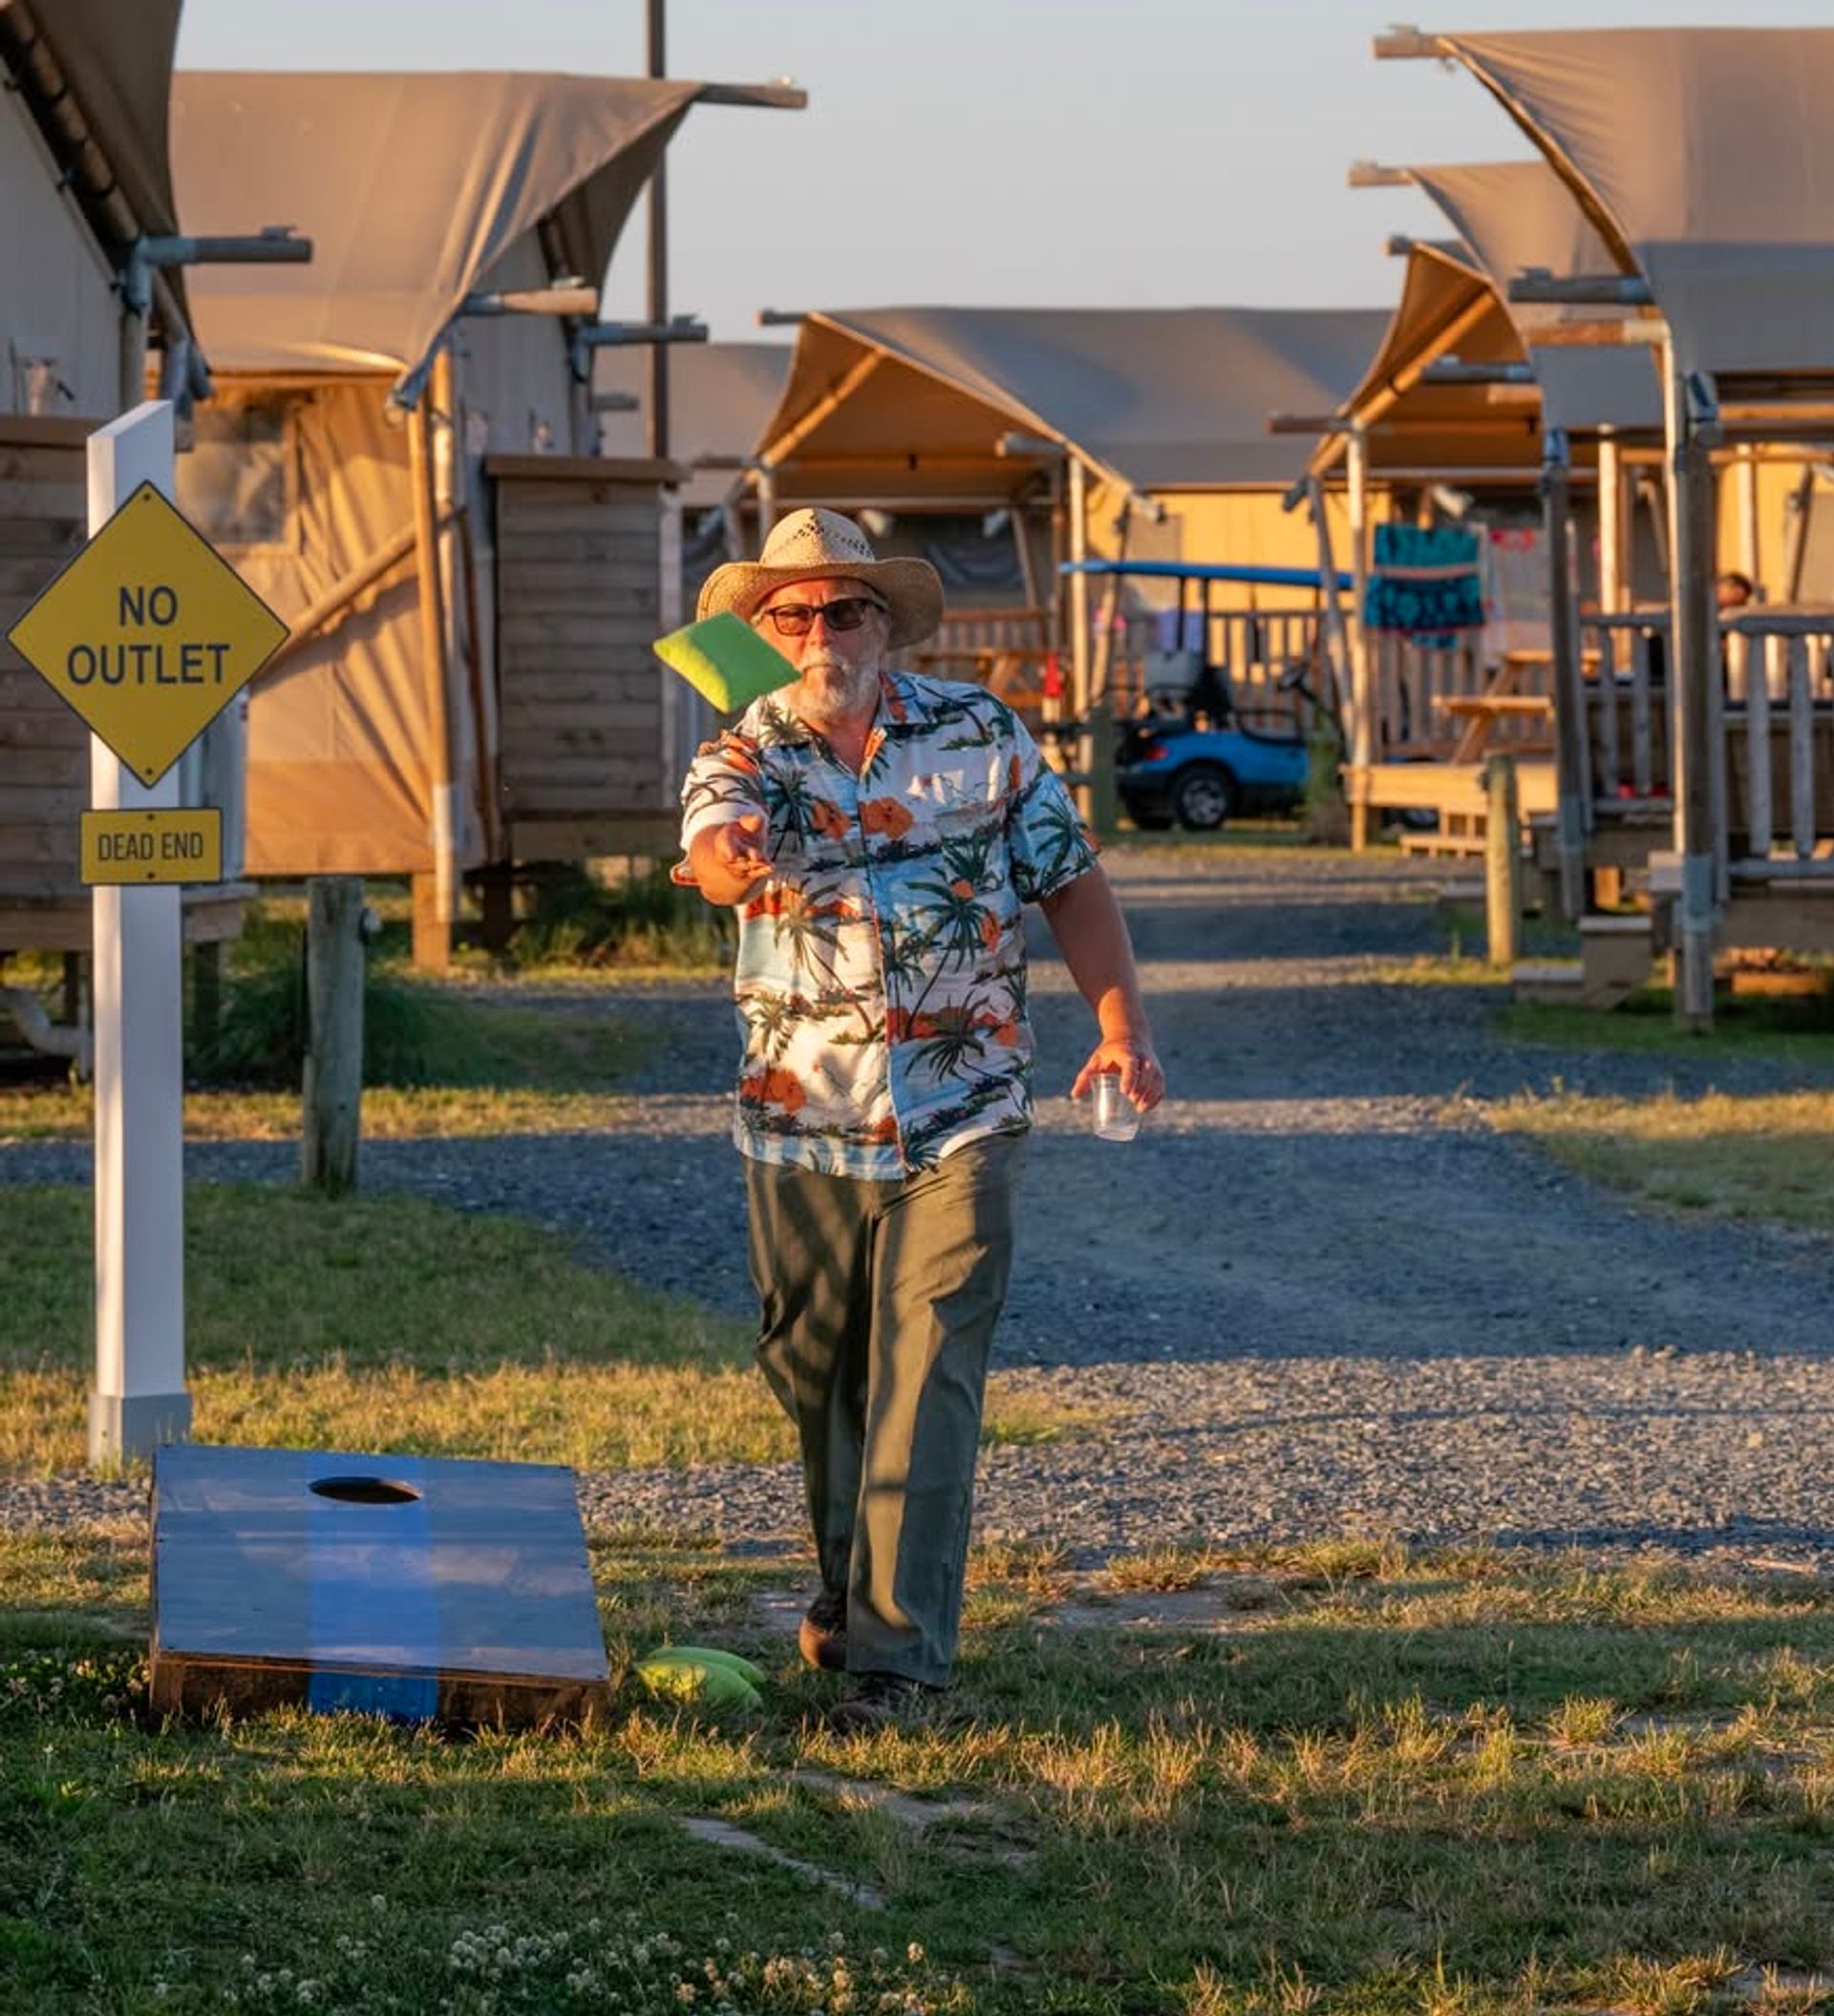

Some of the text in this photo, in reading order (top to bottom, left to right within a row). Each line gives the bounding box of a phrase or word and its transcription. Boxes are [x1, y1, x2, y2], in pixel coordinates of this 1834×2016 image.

[118, 585, 179, 626] NO
[67, 644, 230, 686] OUTLET
[97, 832, 203, 860] DEAD END
